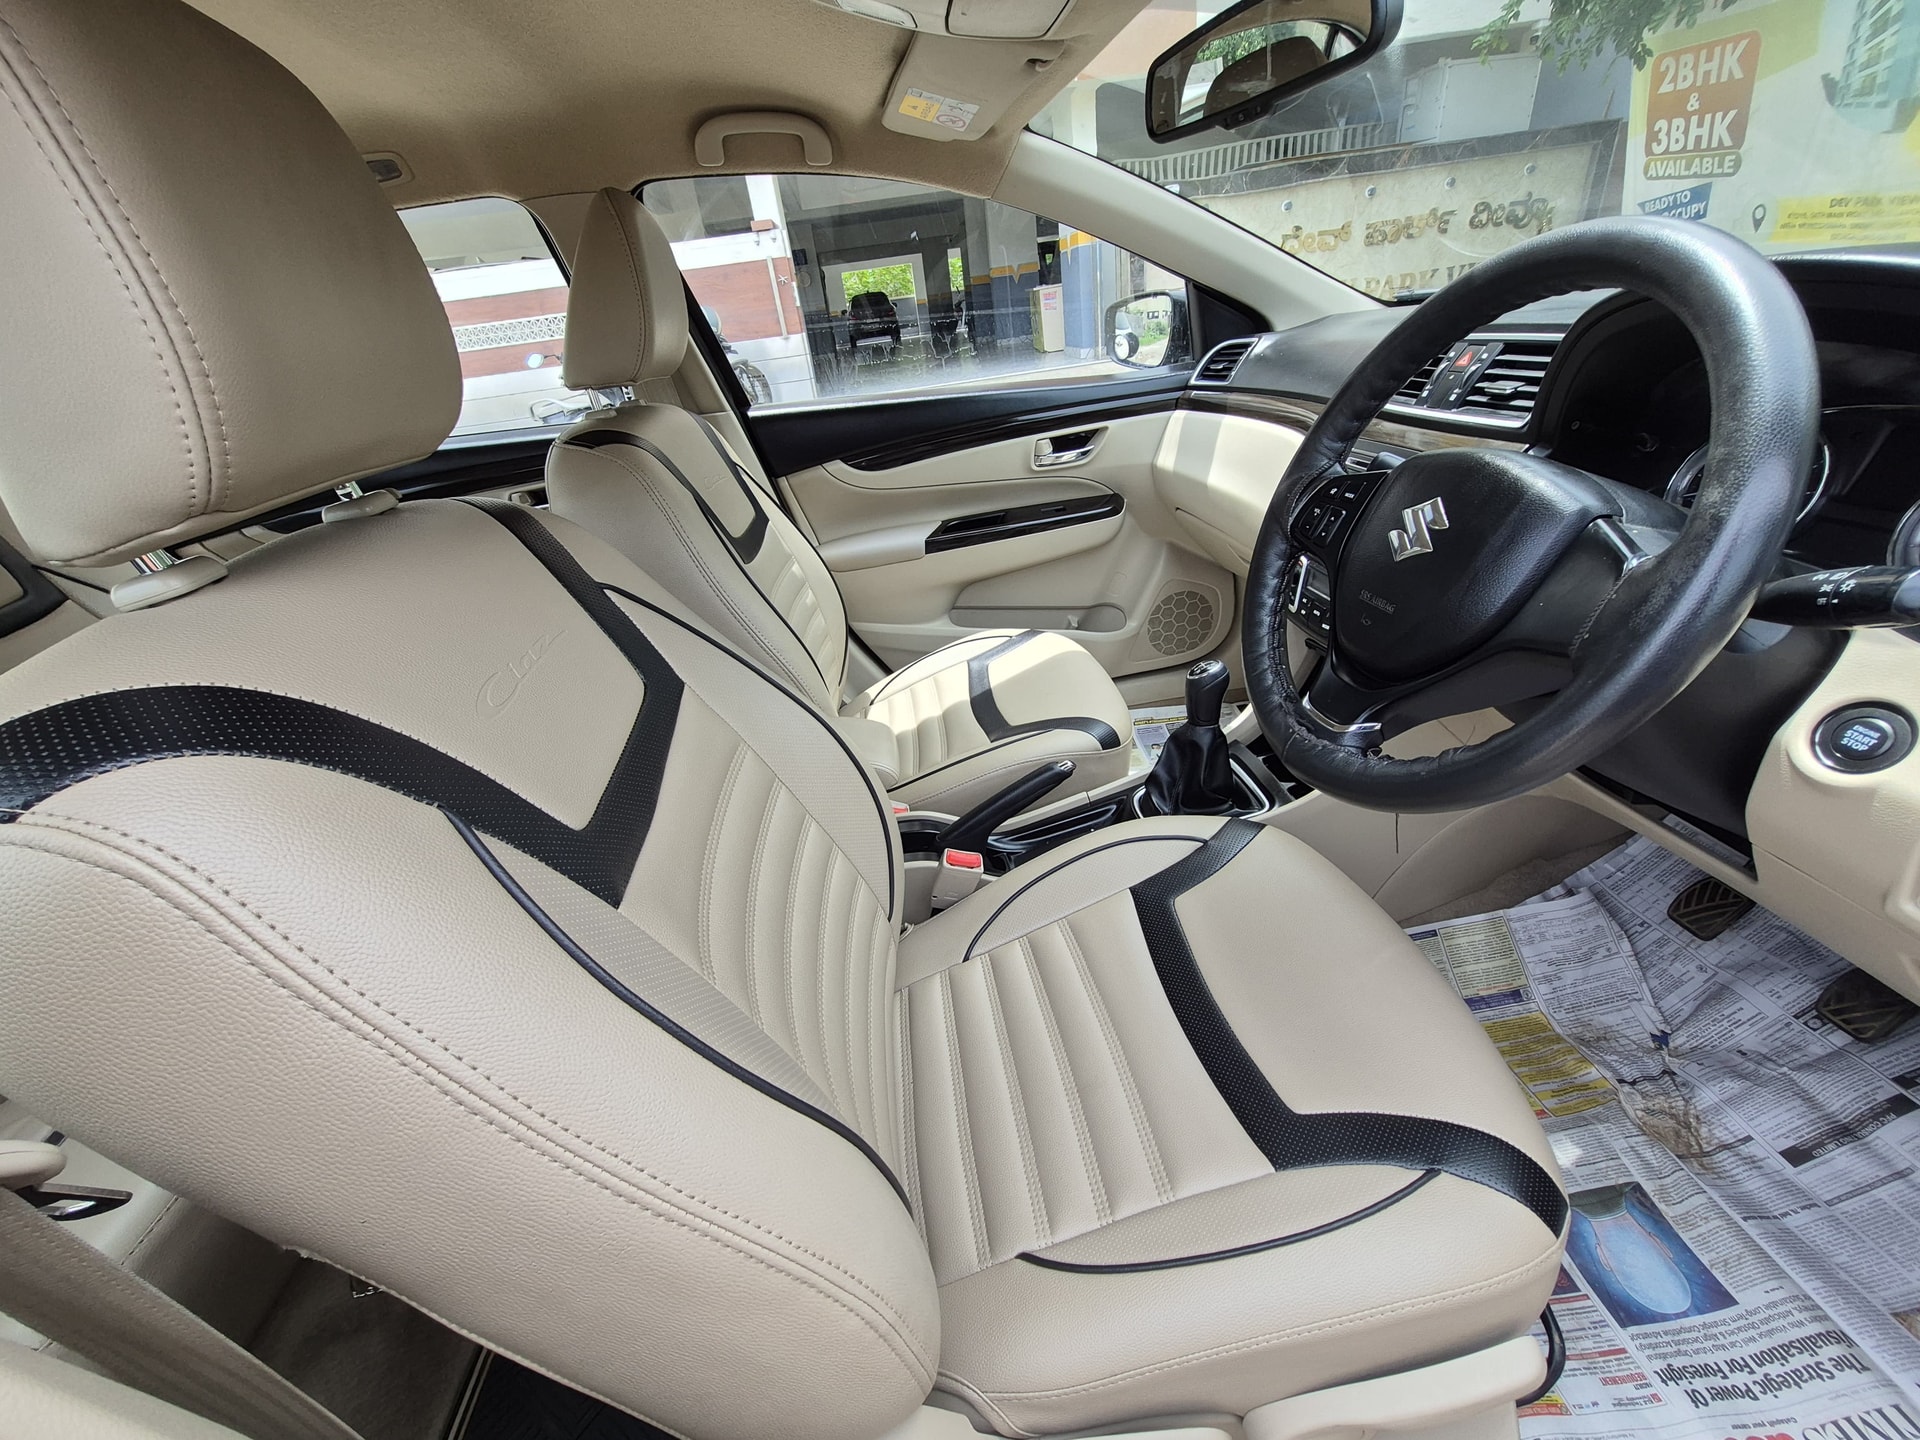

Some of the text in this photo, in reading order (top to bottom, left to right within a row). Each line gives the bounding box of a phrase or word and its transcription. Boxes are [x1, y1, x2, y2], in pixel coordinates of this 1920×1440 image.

[1657, 38, 1750, 94] 2BHK
[1686, 92, 1700, 112] &
[1651, 109, 1738, 155] 3BHK
[1647, 155, 1736, 178] AVAILABLE
[1644, 190, 1691, 213] READY TO
[1372, 594, 1397, 613] AIRBAG
[1840, 738, 1869, 752] STOP
[1844, 729, 1878, 746] START
[1812, 1140, 1841, 1157] LIMITED
[1766, 1294, 1805, 1311] Sustainable
[1730, 1304, 1766, 1321] Long-Term
[1761, 1308, 1795, 1324] Anticipate
[1699, 1317, 1730, 1330] Strategic
[1727, 1320, 1762, 1337] Obstacles
[1757, 1324, 1790, 1340] Visualise
[1787, 1319, 1807, 1330] Who
[1727, 1340, 1743, 1350] Can
[1742, 1334, 1758, 1345] Well
[1692, 1347, 1714, 1356] Future
[1713, 1344, 1729, 1353] Map
[1653, 1329, 1860, 1386] Visualisation For Foresight
[1828, 1352, 1871, 1374] The
[1599, 1372, 1648, 1386] REQUIREMENT
[1753, 1360, 1836, 1399] Strategic
[1684, 1388, 1709, 1409] Of
[1705, 1381, 1760, 1401] Power
[1767, 1416, 1798, 1427] Catapult
